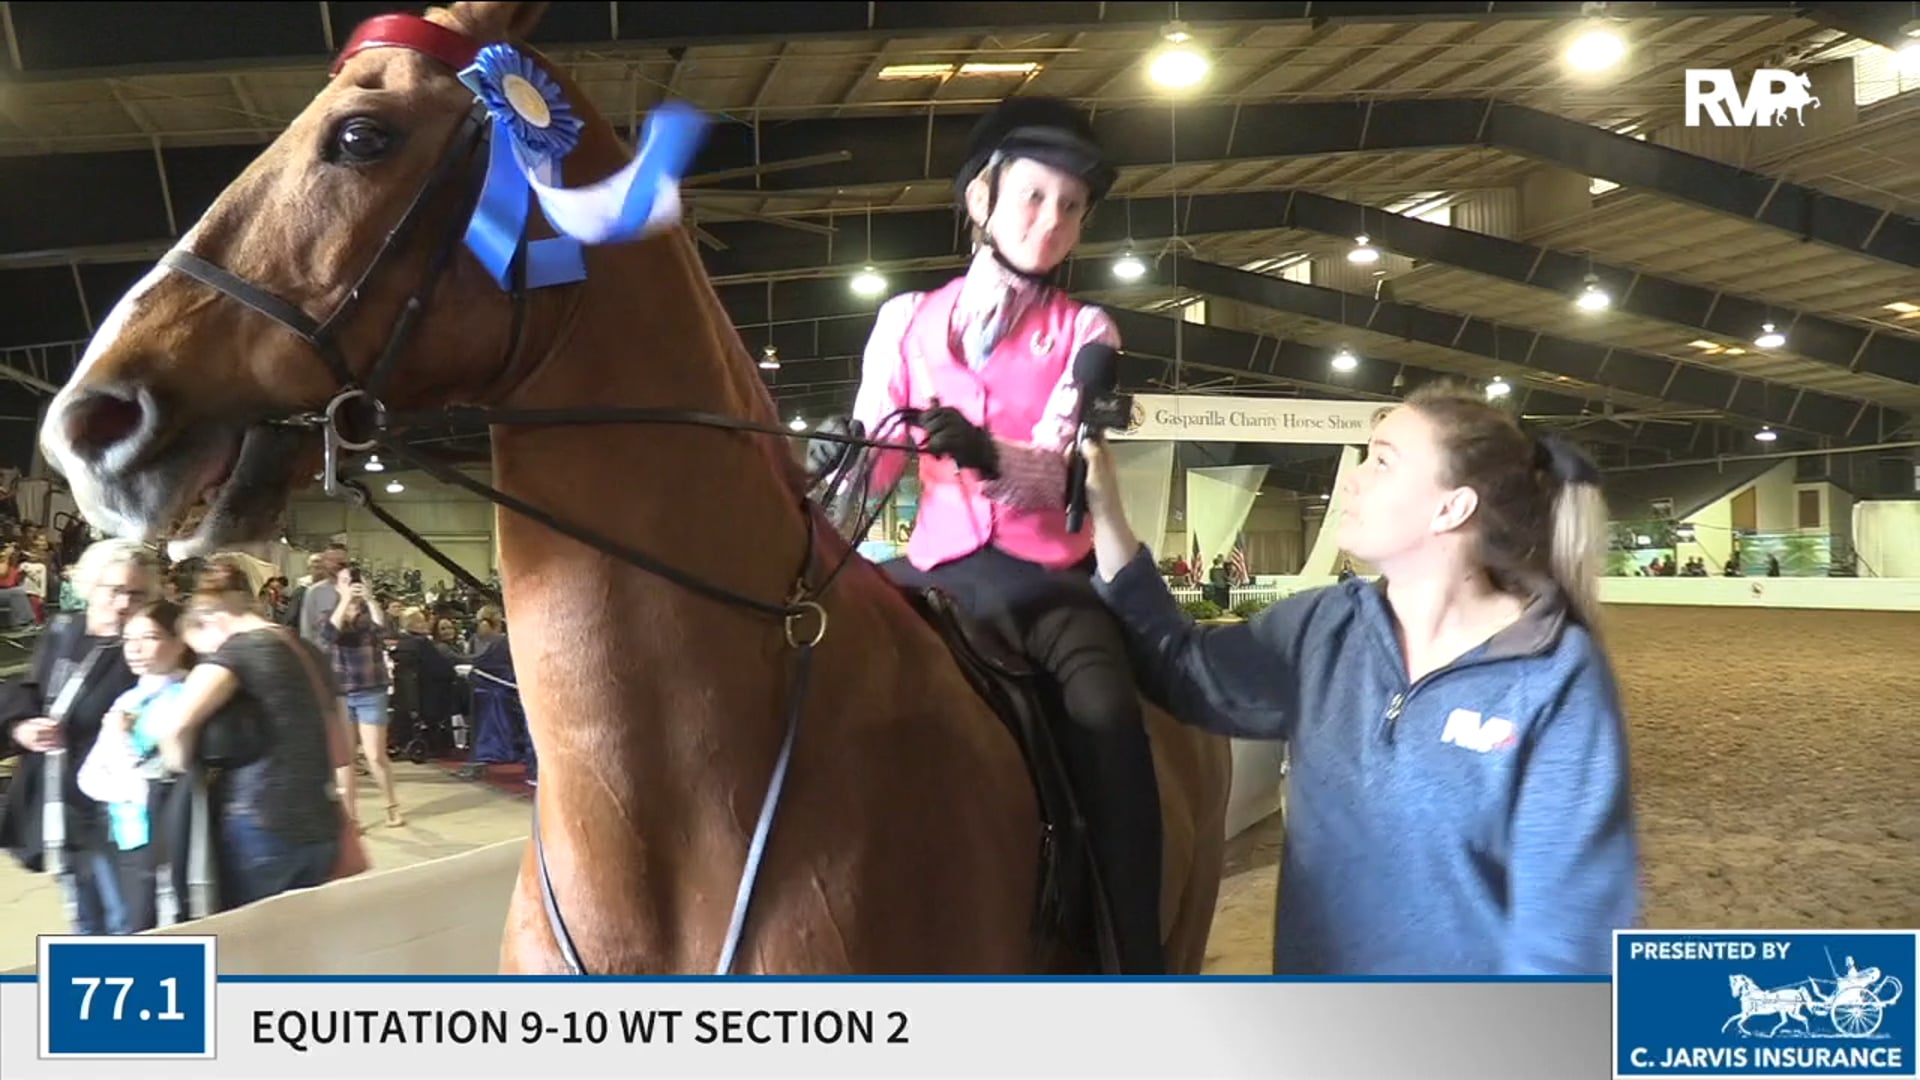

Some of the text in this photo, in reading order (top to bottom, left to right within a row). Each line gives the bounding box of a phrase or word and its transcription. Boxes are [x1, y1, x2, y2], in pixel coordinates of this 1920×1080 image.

[1155, 409, 1363, 431] Gasparilla Charity Horse Show
